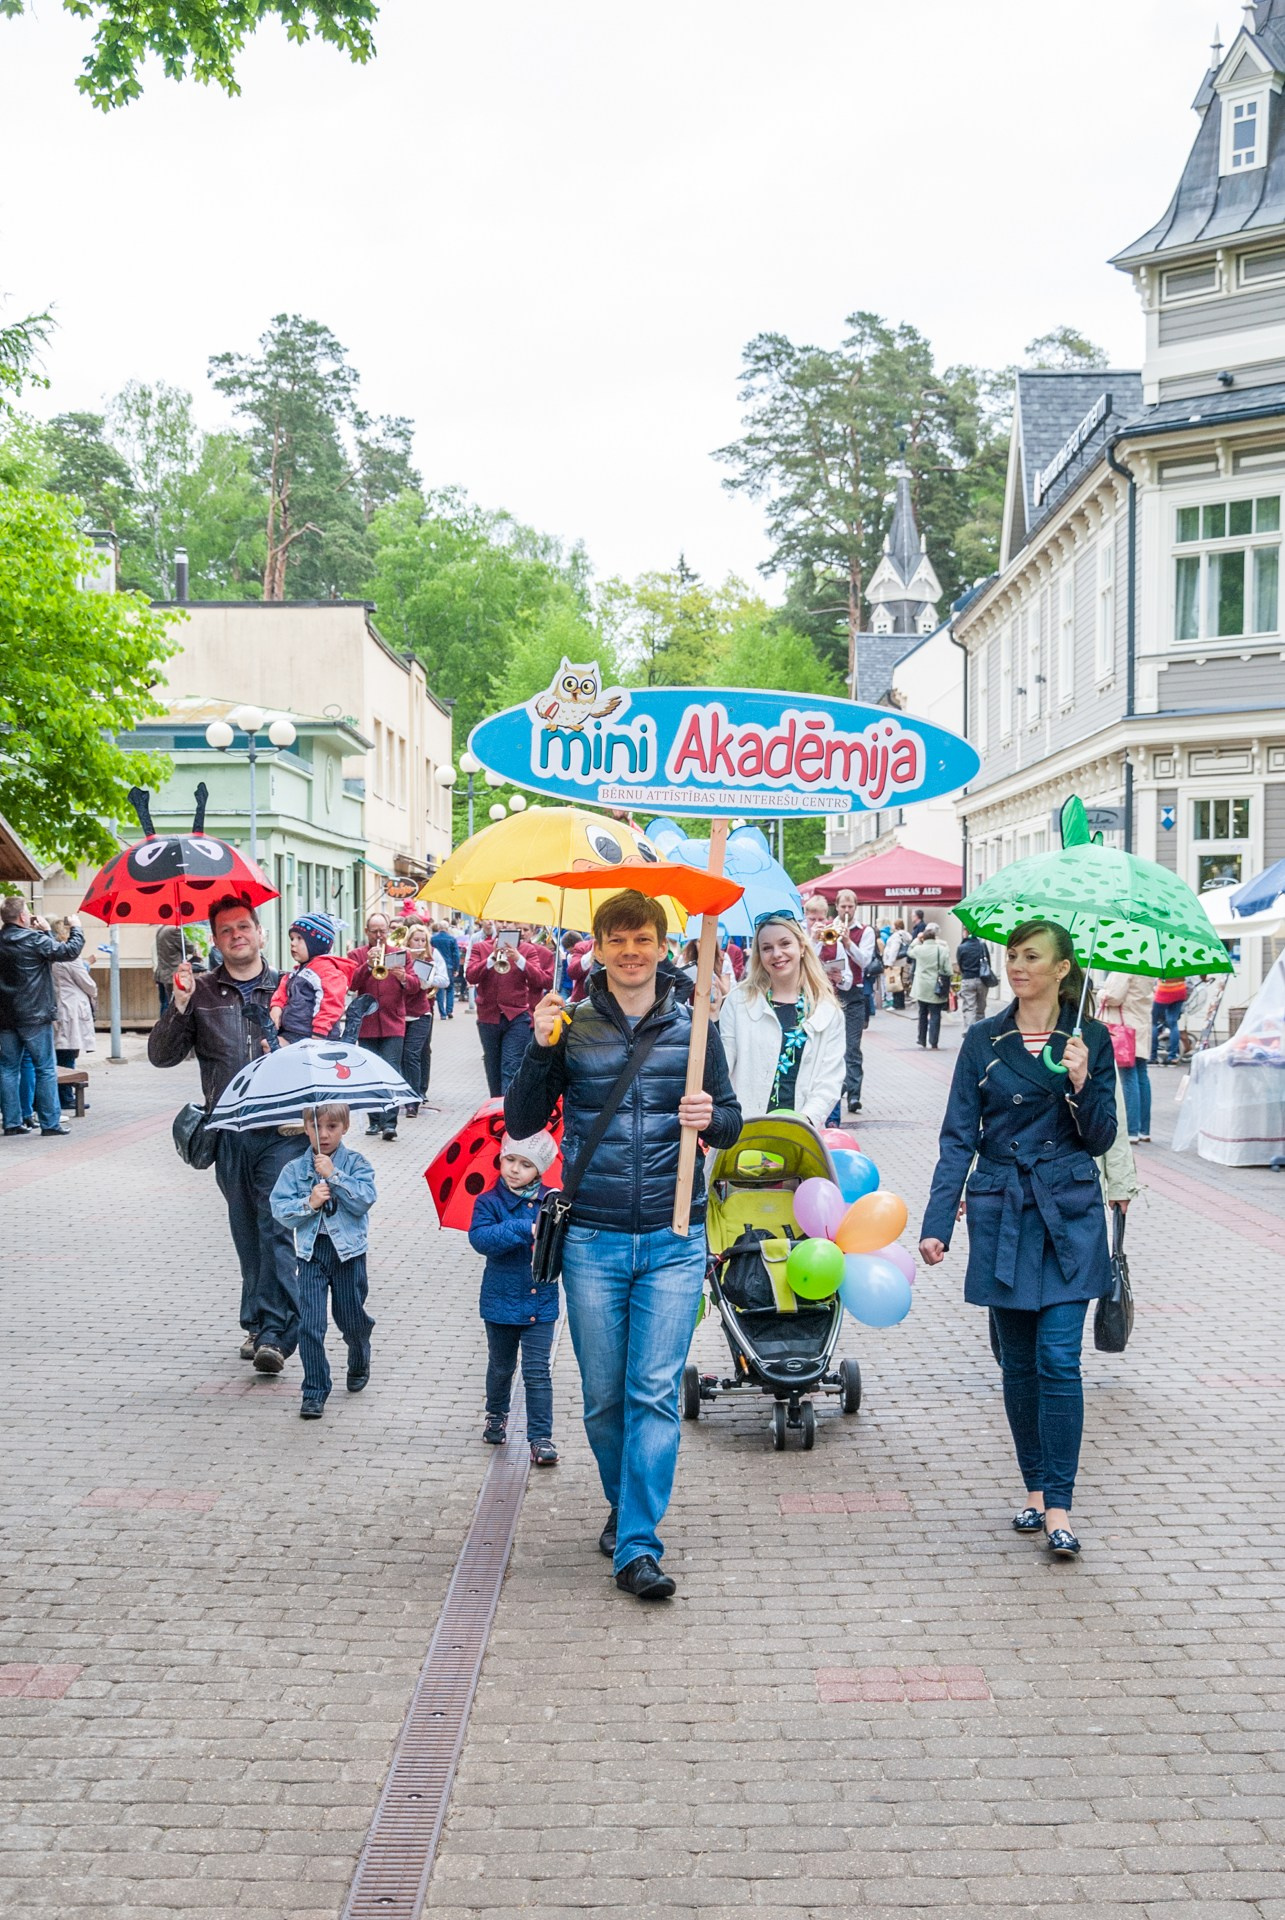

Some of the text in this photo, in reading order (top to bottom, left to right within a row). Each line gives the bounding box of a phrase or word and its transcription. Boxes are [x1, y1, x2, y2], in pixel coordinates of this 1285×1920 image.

[540, 711, 917, 799] mini Akadēmija
[602, 787, 849, 808] BĒRNU ATTĪSTĪBAS UN INTEREŠU CENTRS
